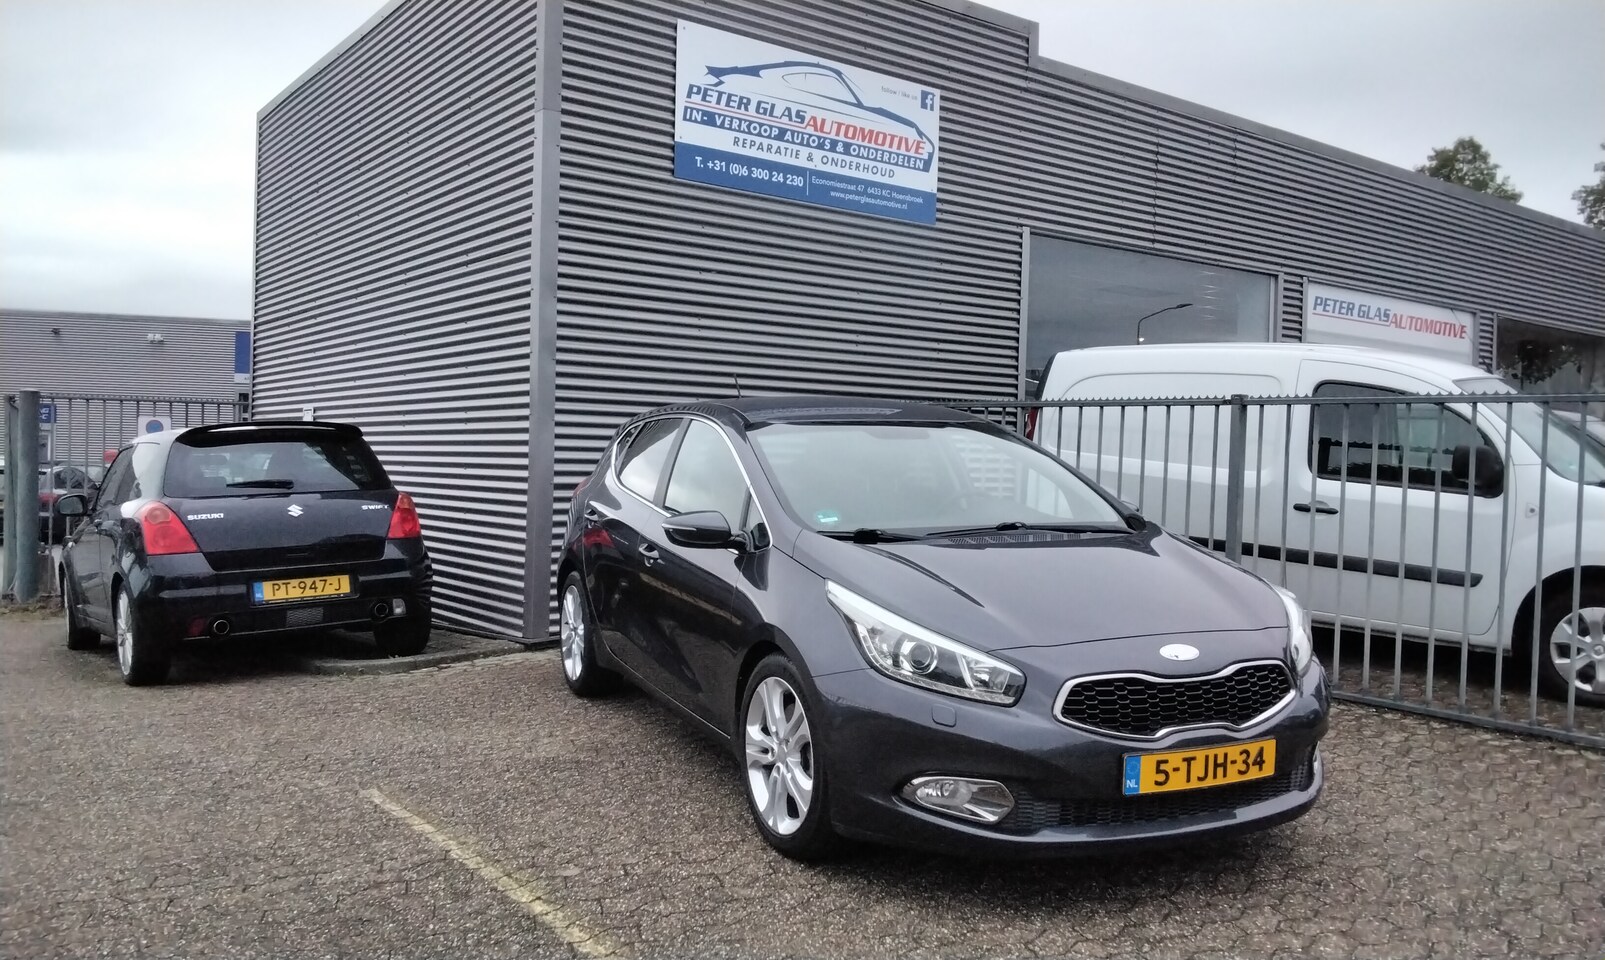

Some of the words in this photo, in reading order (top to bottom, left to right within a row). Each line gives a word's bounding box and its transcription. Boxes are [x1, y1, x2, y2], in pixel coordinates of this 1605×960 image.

[685, 83, 752, 112] PETER
[686, 108, 708, 122] IN-
[715, 114, 779, 138] VERKOOP
[784, 130, 831, 150] AUTO'S
[836, 142, 844, 152] &
[850, 144, 924, 170] ONDERDELEN
[732, 136, 801, 160] REPARATIE
[806, 151, 814, 163] &
[821, 155, 895, 178] ONDERHOUD
[695, 156, 704, 168] T.
[706, 160, 726, 172] +31
[729, 162, 749, 177] (0)6
[751, 167, 769, 180] 300
[771, 171, 784, 183] 24
[786, 174, 804, 187] 230
[811, 176, 857, 191] Economiestraat
[857, 184, 865, 193] 47
[867, 186, 882, 196] 6433
[882, 189, 891, 198] KC
[830, 190, 908, 210] www.peterglasautomotive.nl
[1313, 296, 1355, 317] PETER
[272, 577, 342, 597] PT-947-J
[1153, 745, 1266, 787] 5-TJH-34
[1126, 779, 1138, 788] NL
